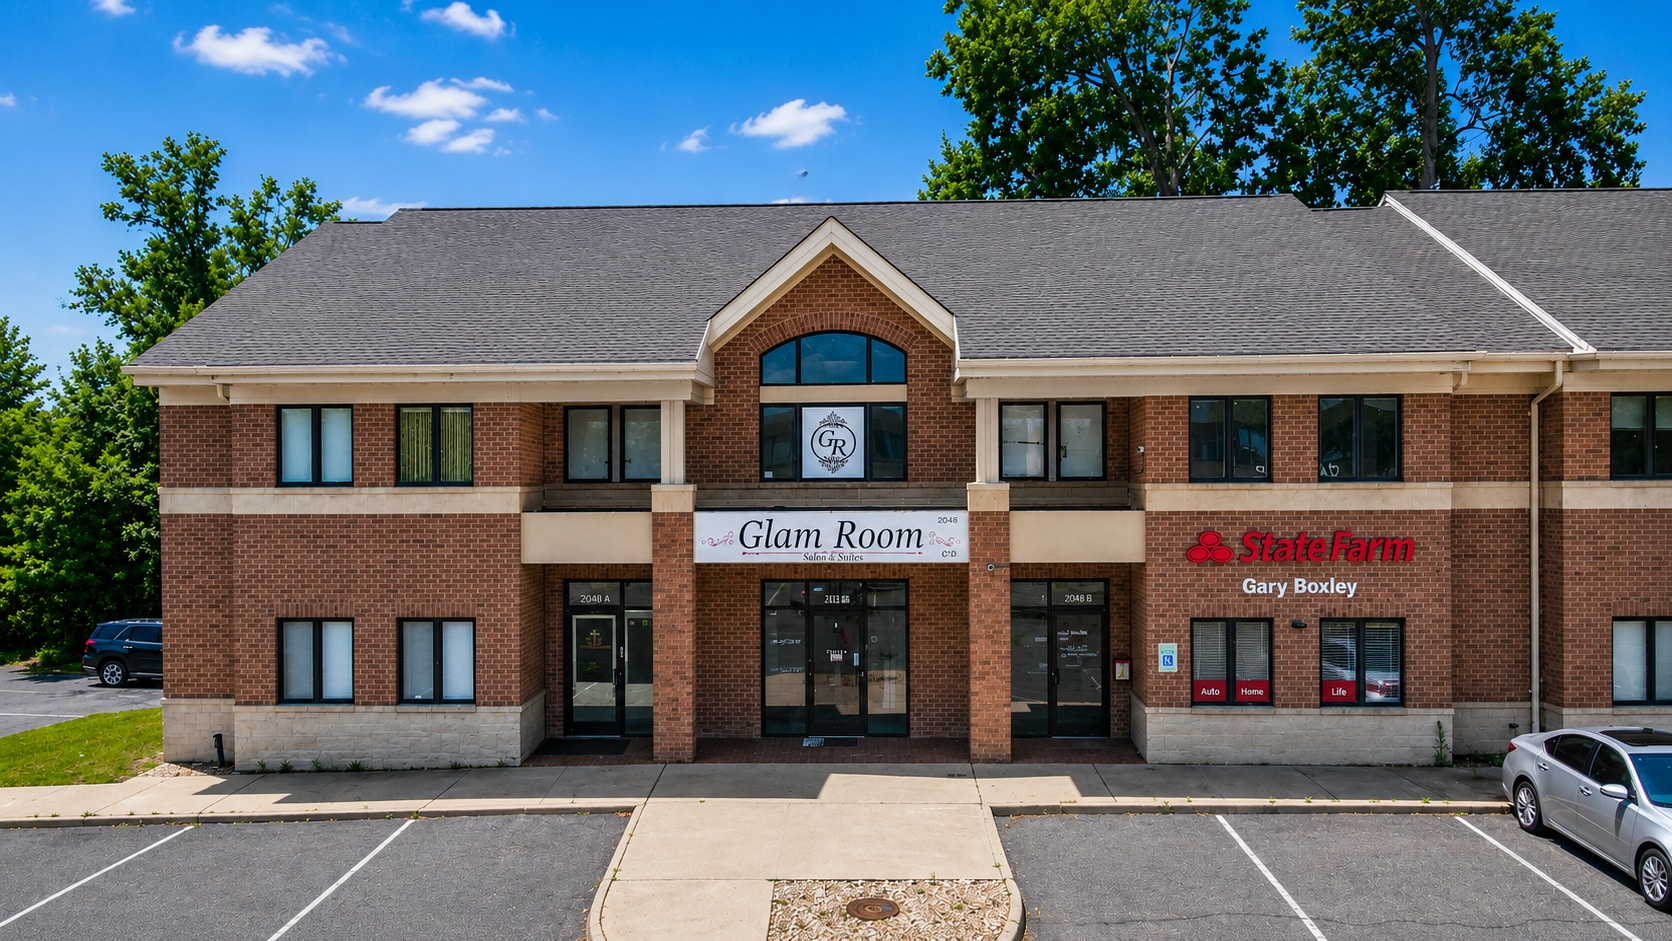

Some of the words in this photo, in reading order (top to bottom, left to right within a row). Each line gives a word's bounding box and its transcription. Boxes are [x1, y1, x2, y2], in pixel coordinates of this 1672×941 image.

[938, 516, 958, 524] 2048
[739, 518, 822, 550] Glam
[834, 520, 924, 550] Room
[803, 552, 827, 561] Salon
[1242, 577, 1288, 598] Gary
[1294, 577, 1358, 598] Boxley
[604, 594, 611, 603] A
[1200, 687, 1220, 696] Auto
[1241, 687, 1264, 696] Home
[1331, 687, 1347, 696] Life
